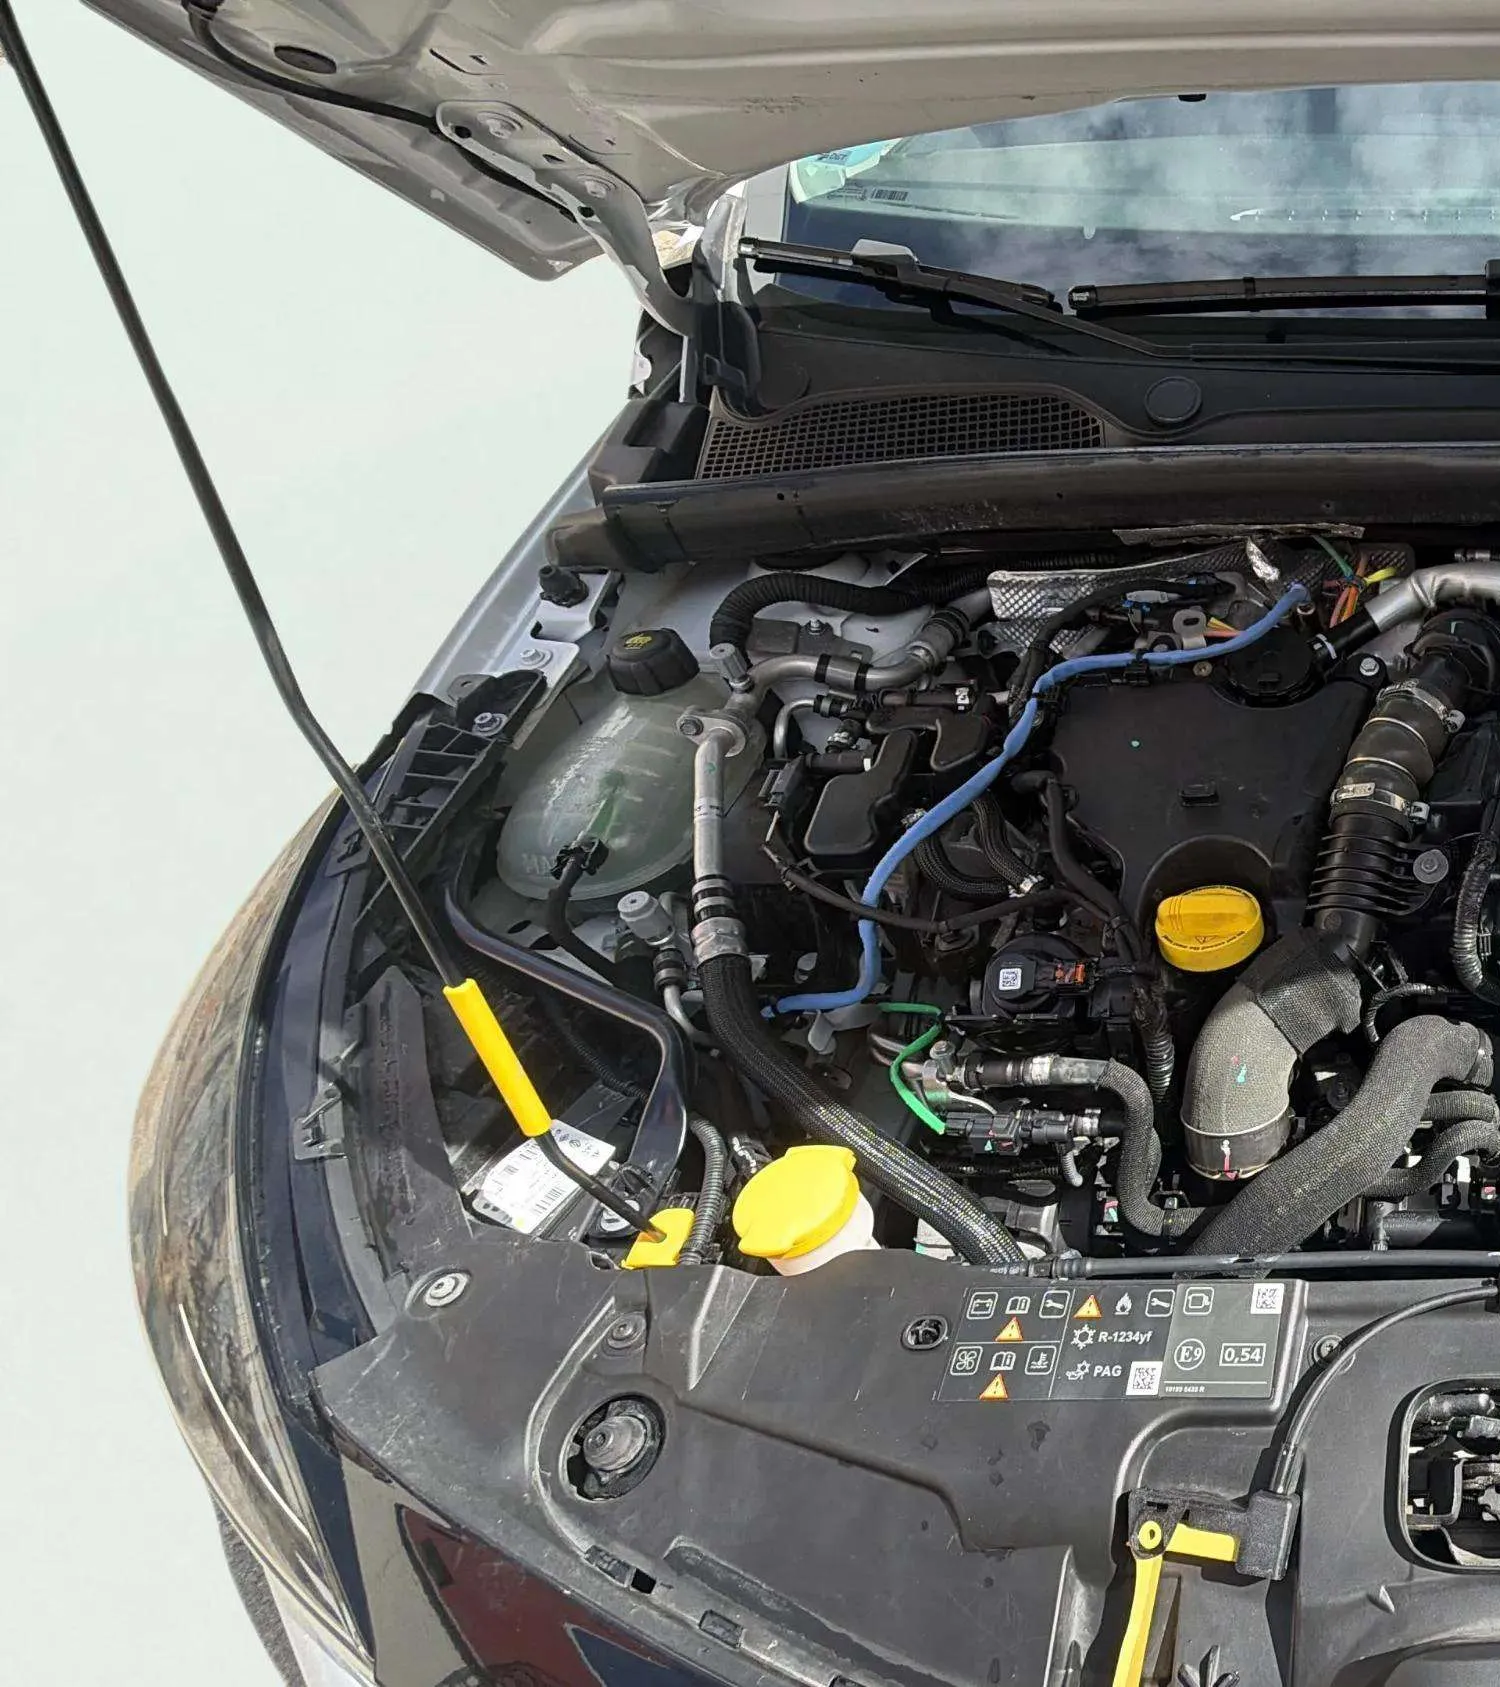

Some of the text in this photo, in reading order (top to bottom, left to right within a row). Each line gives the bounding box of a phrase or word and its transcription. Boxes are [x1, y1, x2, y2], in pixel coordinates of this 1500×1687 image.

[1098, 1331, 1153, 1344] R-1234yf
[1179, 1346, 1202, 1363] E9
[1224, 1347, 1262, 1364] 0,54
[1093, 1366, 1122, 1378] PAG
